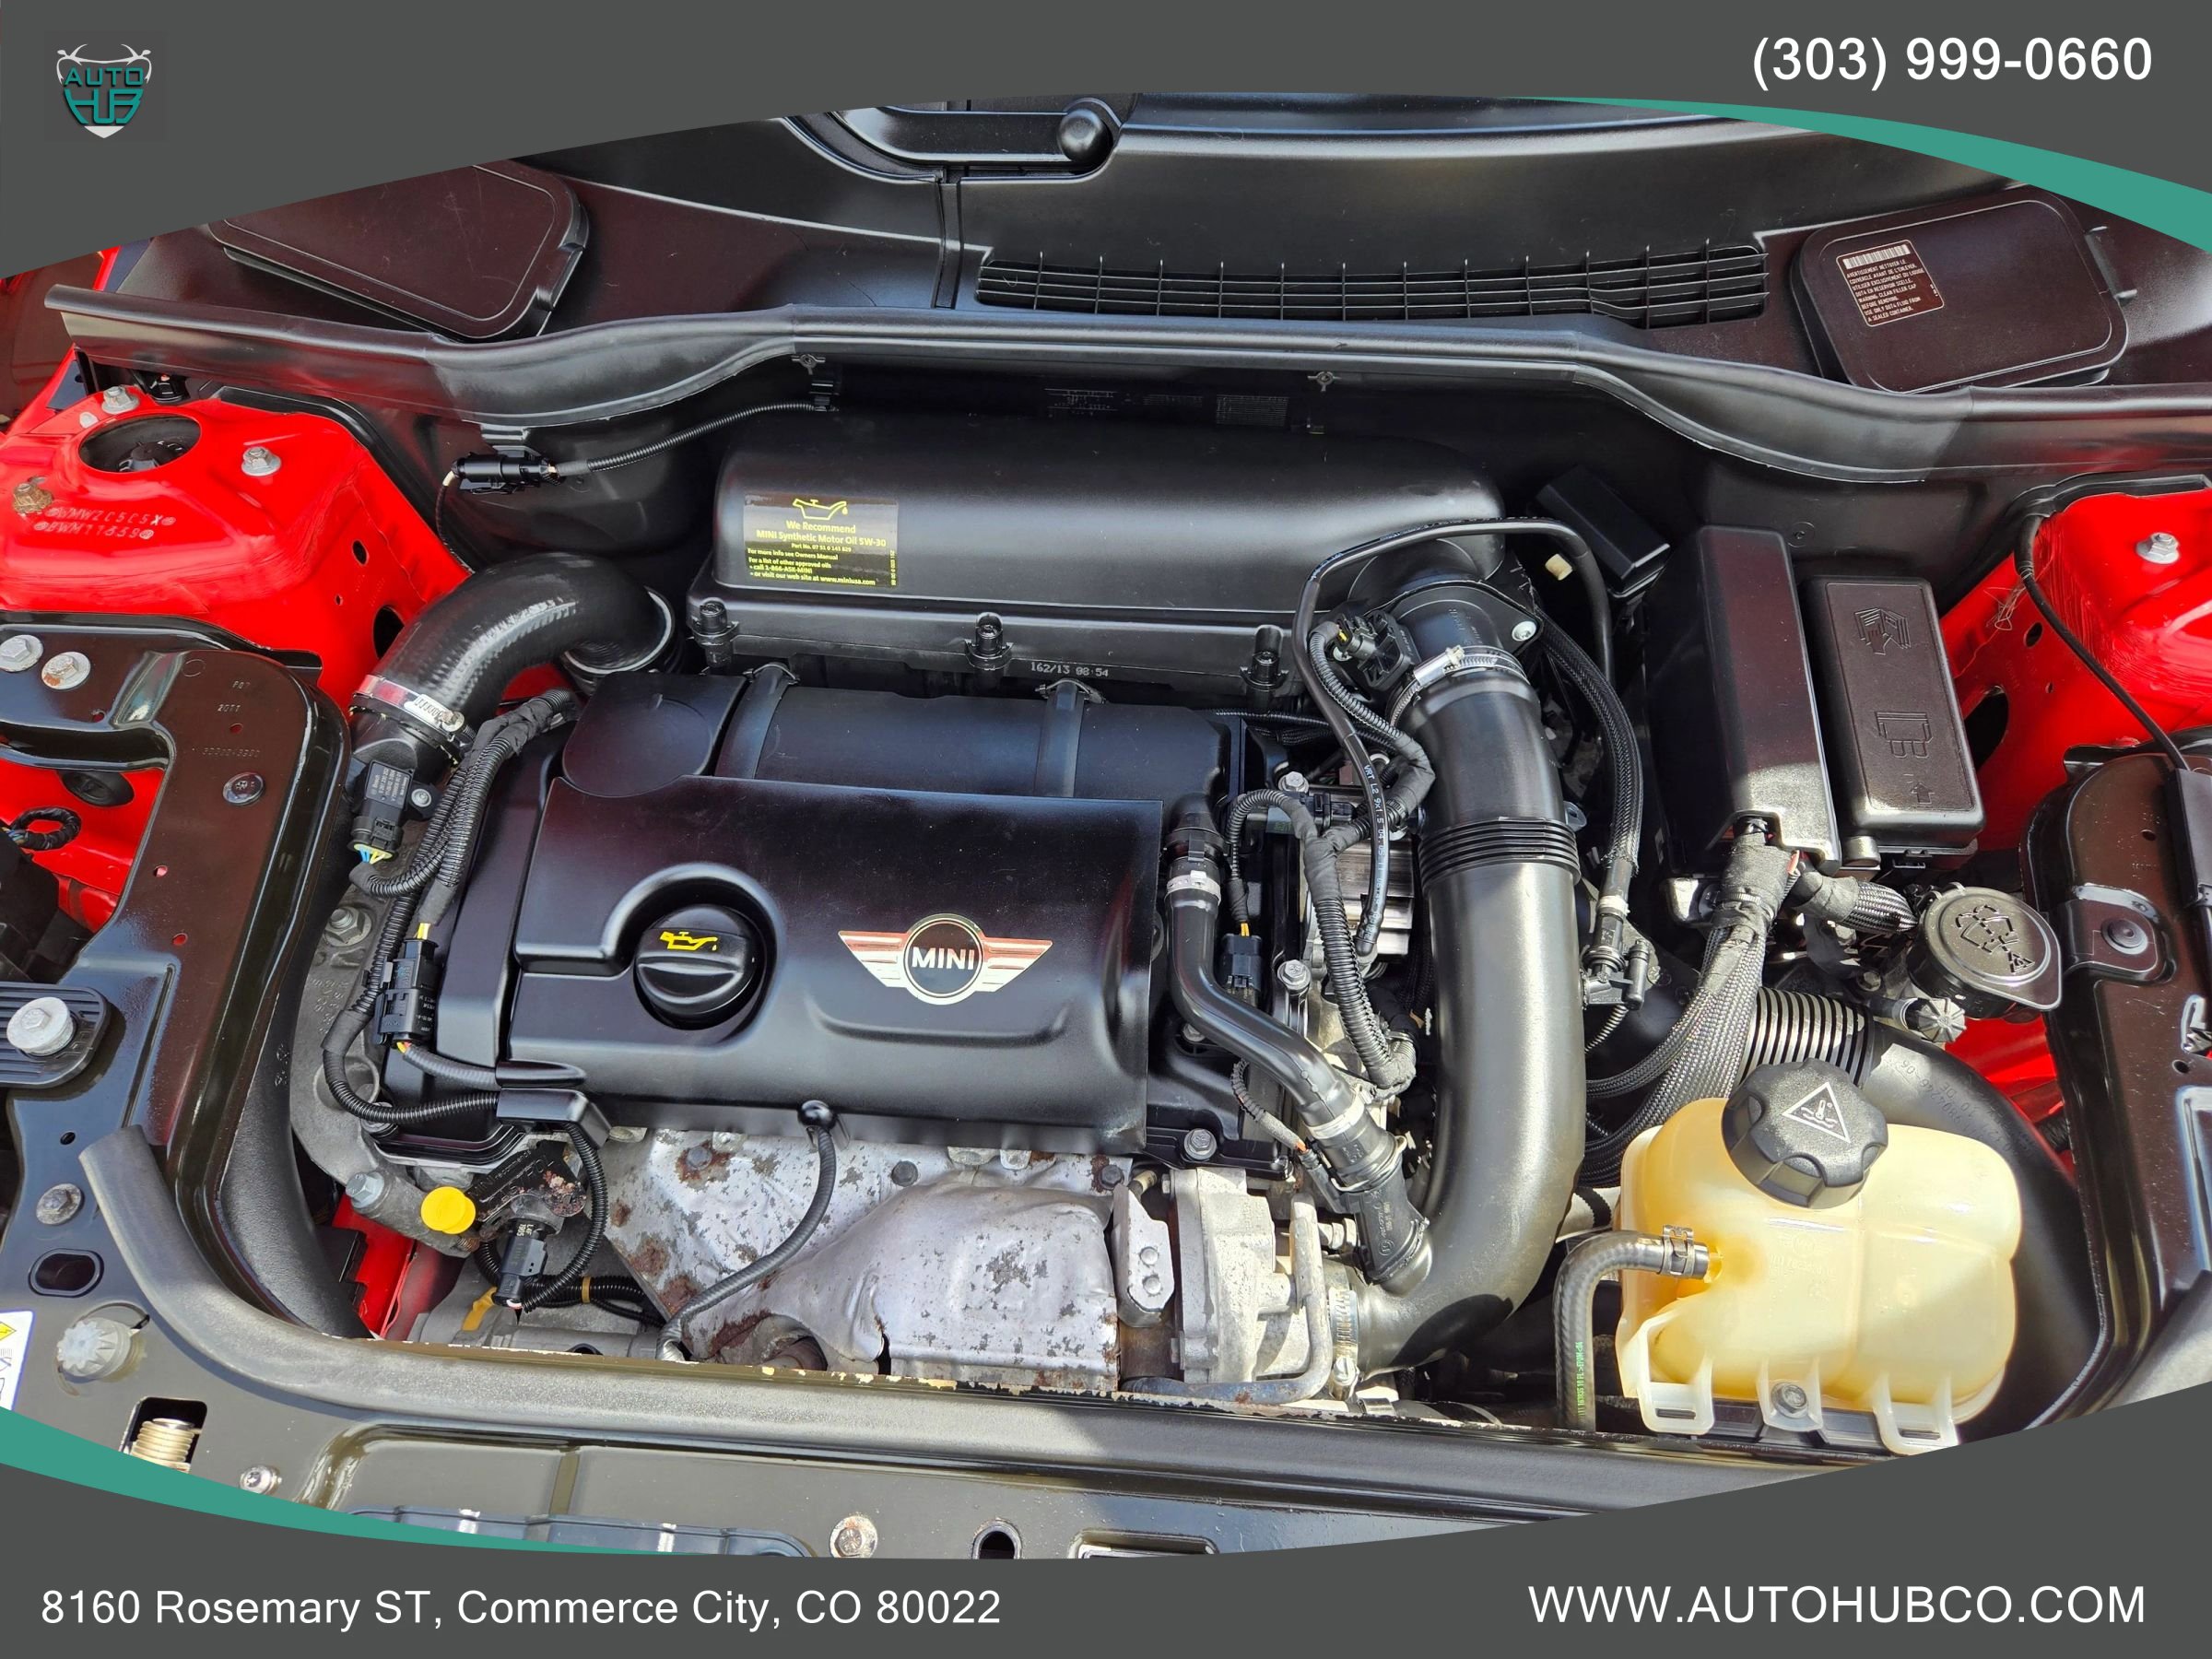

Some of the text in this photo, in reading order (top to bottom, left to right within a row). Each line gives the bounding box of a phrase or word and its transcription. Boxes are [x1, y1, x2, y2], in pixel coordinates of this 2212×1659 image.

[786, 520, 855, 534] We Recommend
[757, 530, 886, 547] MINI Synthetic Motor Oil 5W-30
[1363, 764, 1375, 780] VRT
[912, 947, 975, 970] MINI
